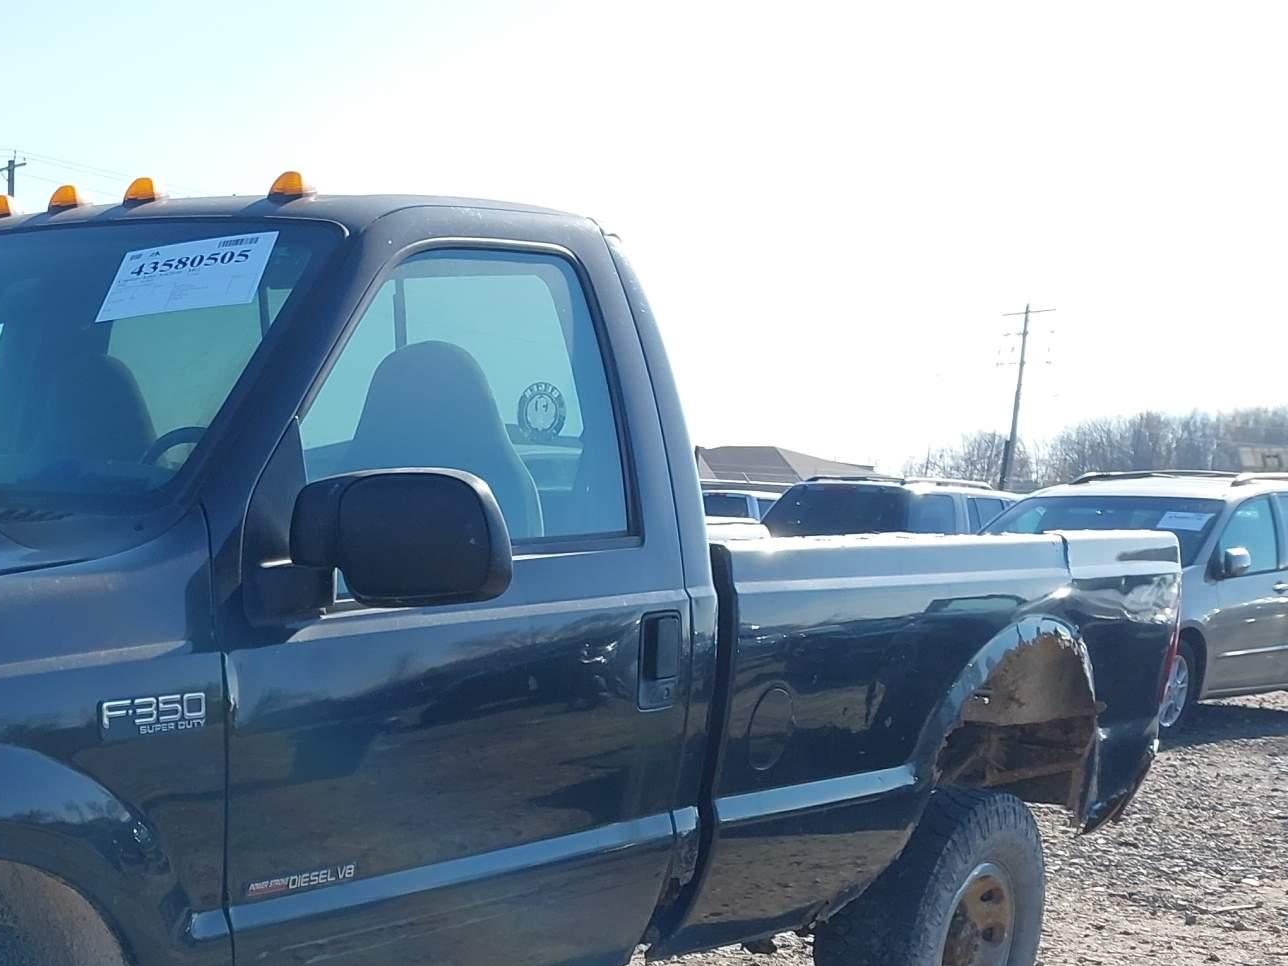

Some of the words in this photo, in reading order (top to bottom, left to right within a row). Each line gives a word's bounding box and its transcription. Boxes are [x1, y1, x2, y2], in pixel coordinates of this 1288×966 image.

[130, 248, 252, 278] 43580505
[139, 722, 175, 735] SUPER
[177, 718, 206, 730] DUTY
[288, 869, 336, 889] DIESEL
[337, 864, 355, 880] V8
